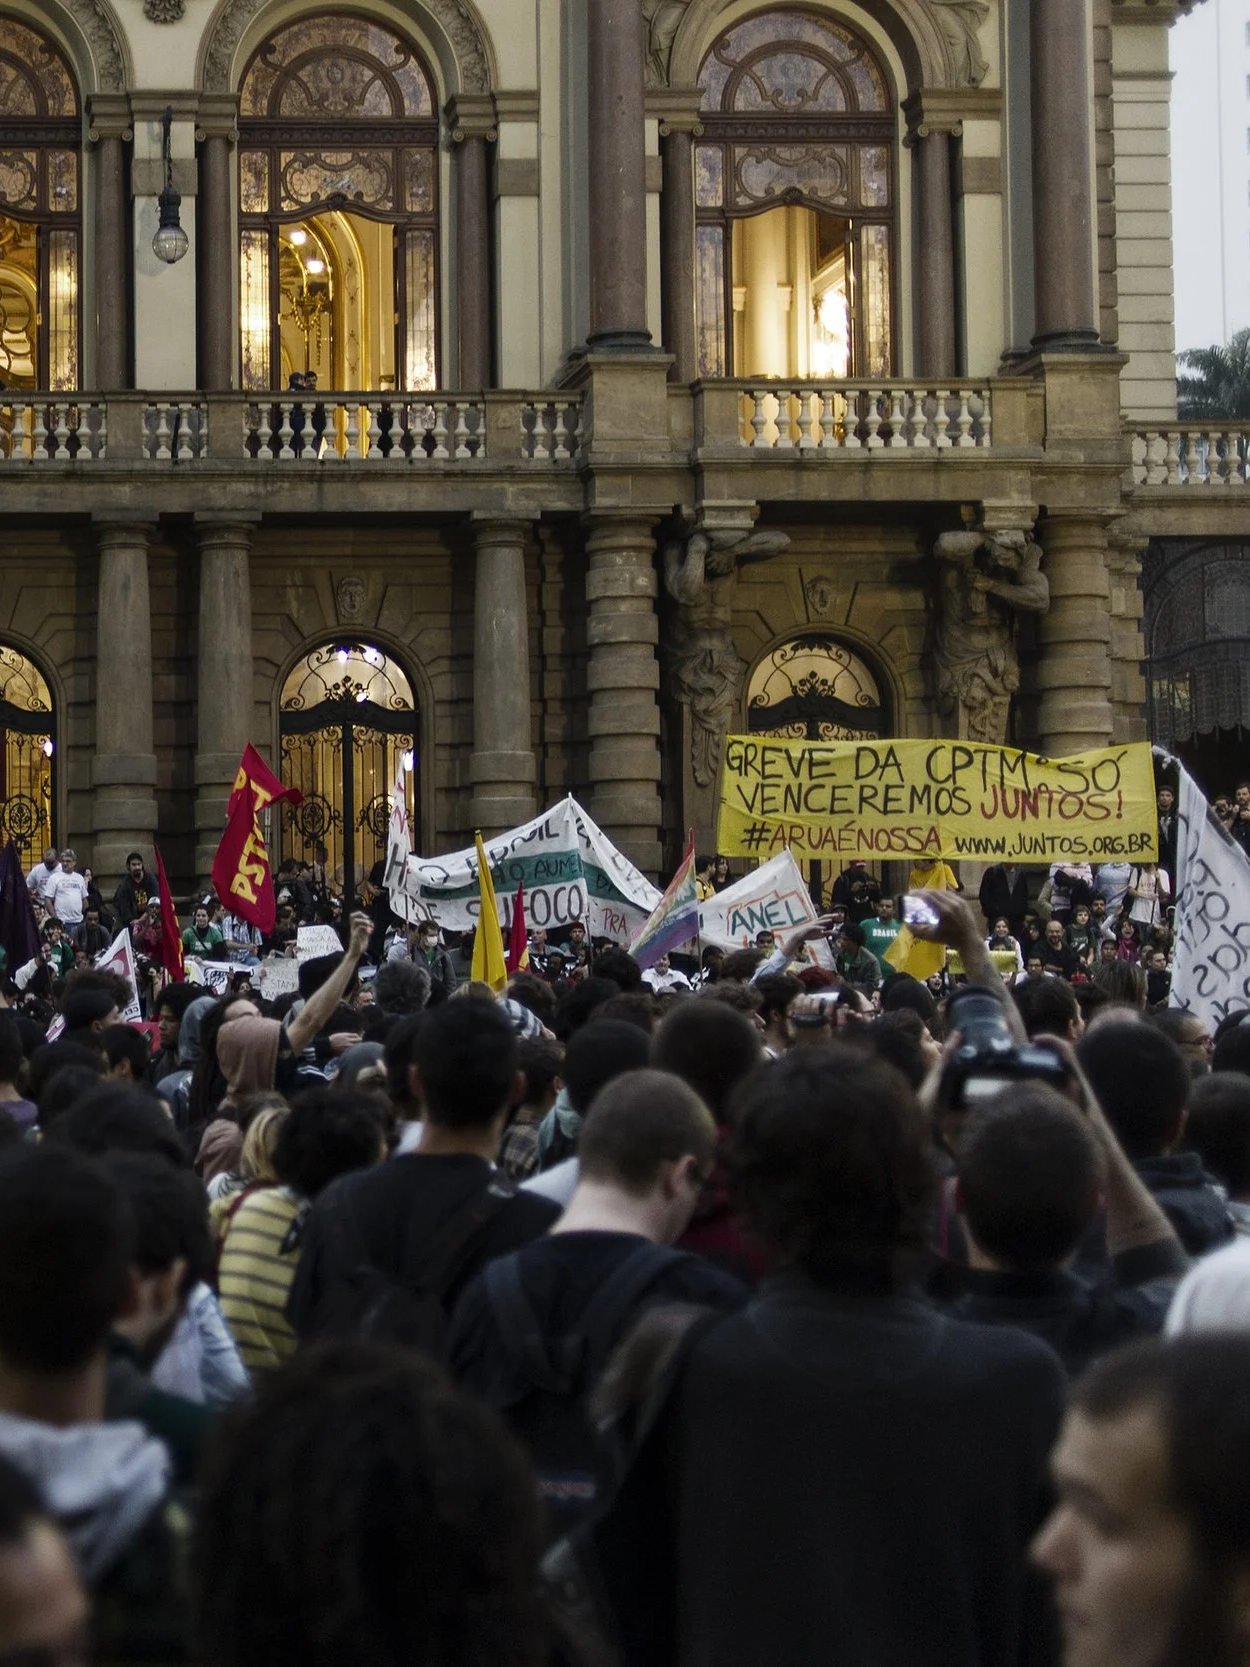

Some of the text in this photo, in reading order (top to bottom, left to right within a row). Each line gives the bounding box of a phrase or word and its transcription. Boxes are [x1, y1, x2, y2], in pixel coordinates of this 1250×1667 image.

[726, 740, 836, 781] GREVE
[854, 745, 904, 782] DA
[1057, 750, 1128, 794] SÓ
[736, 783, 1123, 822] VENCEREMOS JUNTOS!
[741, 820, 941, 853] #ARUAÉNOSSA
[955, 832, 1154, 858] WWW.JUNTOS.ORG.BR
[602, 907, 629, 936] PRA
[731, 899, 808, 936] ANEL
[872, 928, 898, 937] BRASIL
